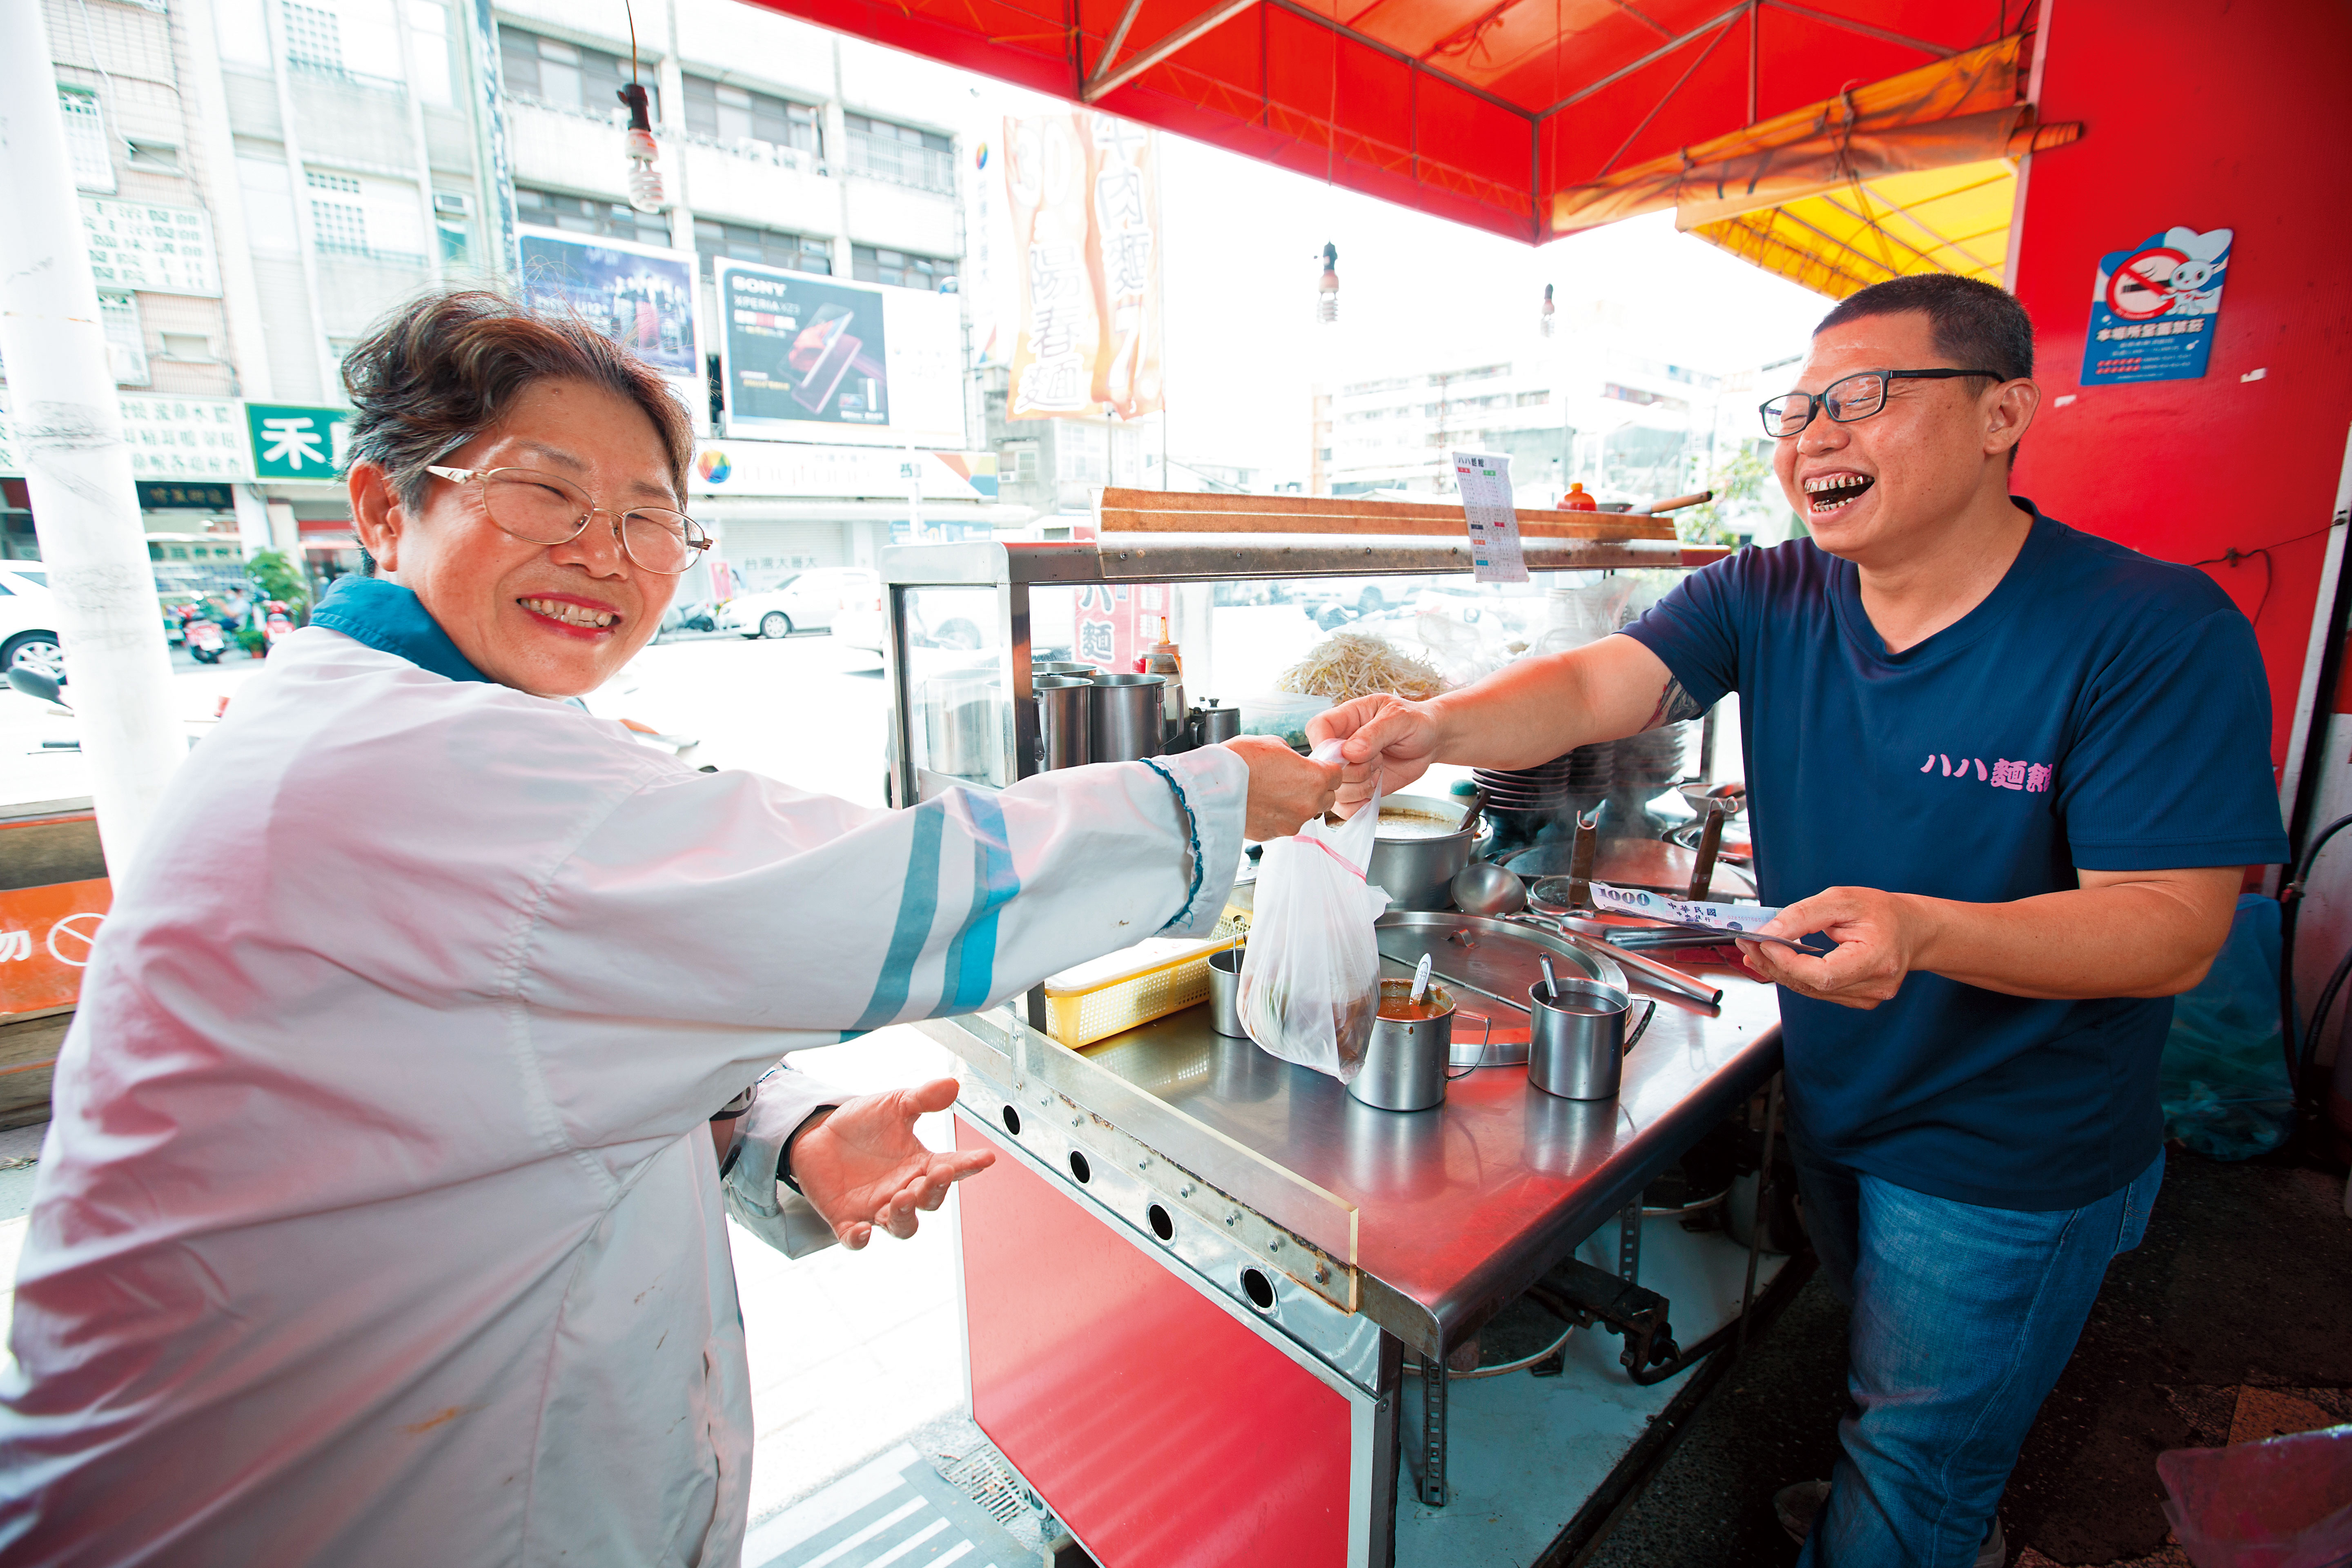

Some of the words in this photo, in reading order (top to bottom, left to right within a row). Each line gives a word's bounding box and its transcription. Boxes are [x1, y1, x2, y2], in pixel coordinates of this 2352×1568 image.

[732, 276, 788, 297] SONY
[1017, 243, 1081, 408] 陽春麵
[1459, 457, 1485, 468] 八八麵館
[1598, 888, 1650, 906] 1000
[1668, 902, 1717, 917] 中華民國
[1676, 911, 1711, 922] 中央銀行
